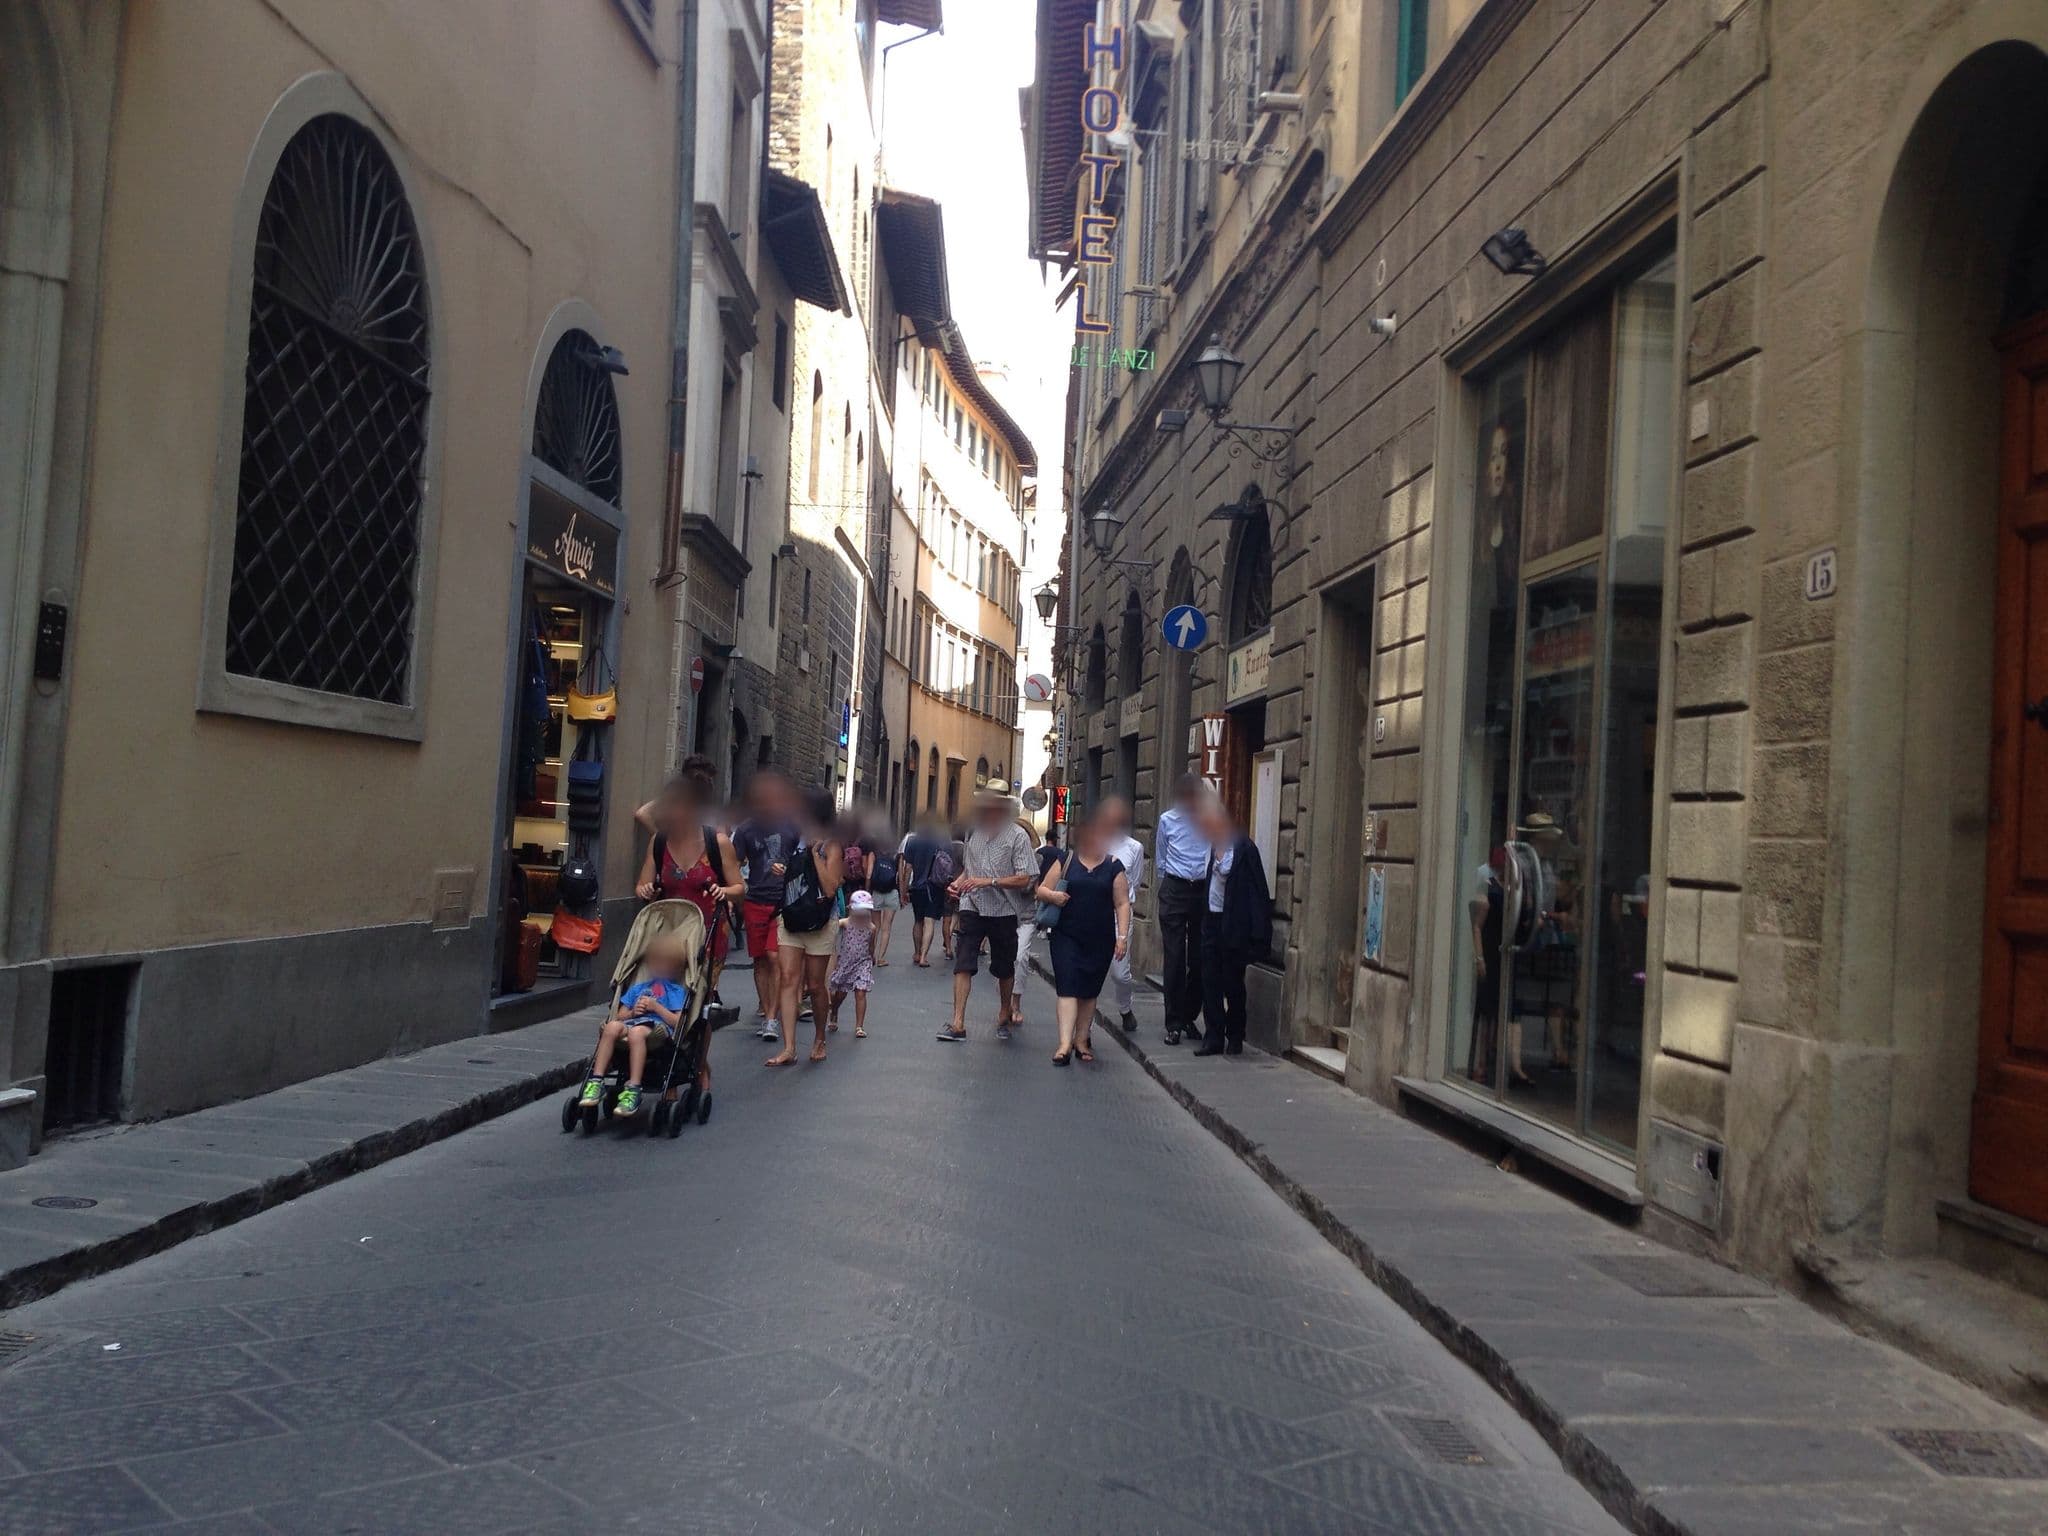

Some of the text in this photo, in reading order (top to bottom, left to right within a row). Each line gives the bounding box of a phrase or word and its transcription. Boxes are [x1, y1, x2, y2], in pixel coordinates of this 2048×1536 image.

[1075, 22, 1125, 334] HOTEL
[1070, 345, 1155, 371] DE LANZI
[554, 513, 595, 581] Amici
[1810, 556, 1832, 593] 15
[1057, 714, 1065, 765] TABACCHI
